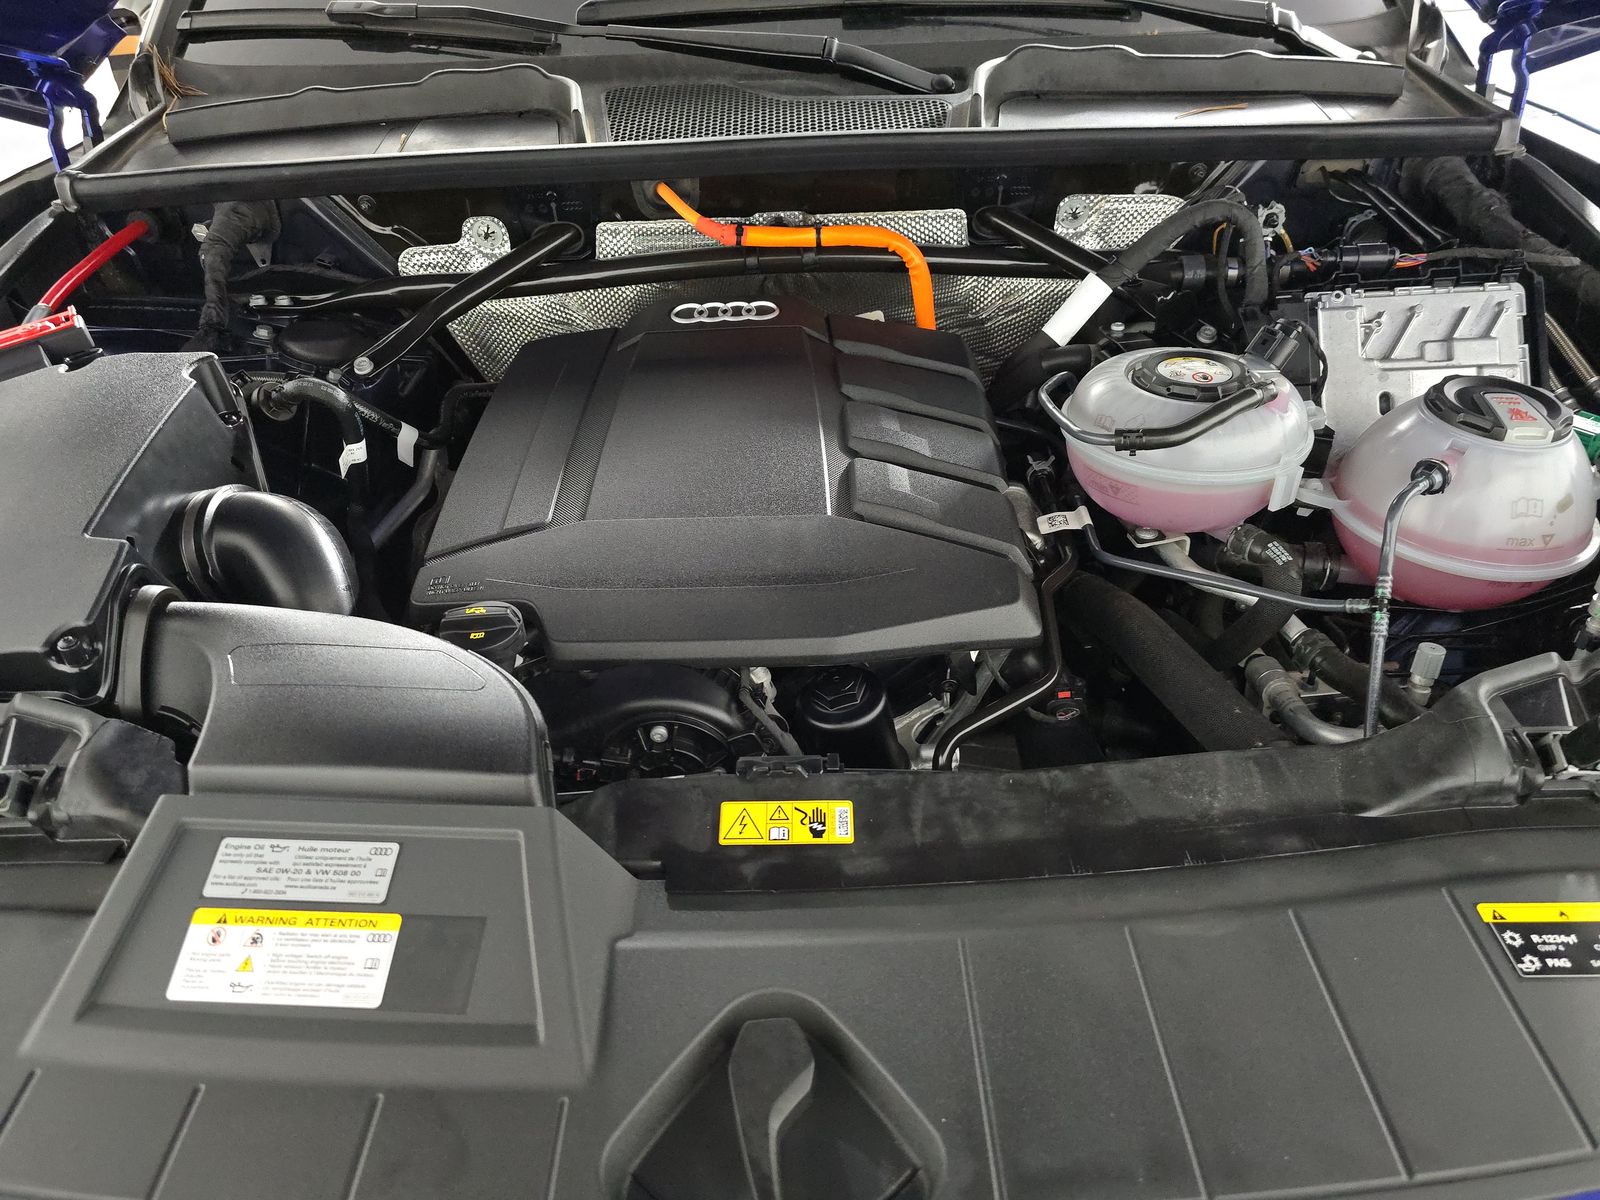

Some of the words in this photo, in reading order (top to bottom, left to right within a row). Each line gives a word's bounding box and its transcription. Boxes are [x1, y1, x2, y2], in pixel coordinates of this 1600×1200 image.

[1505, 537, 1535, 547] max
[224, 843, 251, 852] Engine
[253, 843, 266, 851] Oil
[298, 846, 318, 854] Huile
[275, 868, 303, 876] 0W-20
[234, 915, 298, 926] WARNING
[304, 918, 378, 928] ATTENTION
[1545, 958, 1572, 968] PAG
